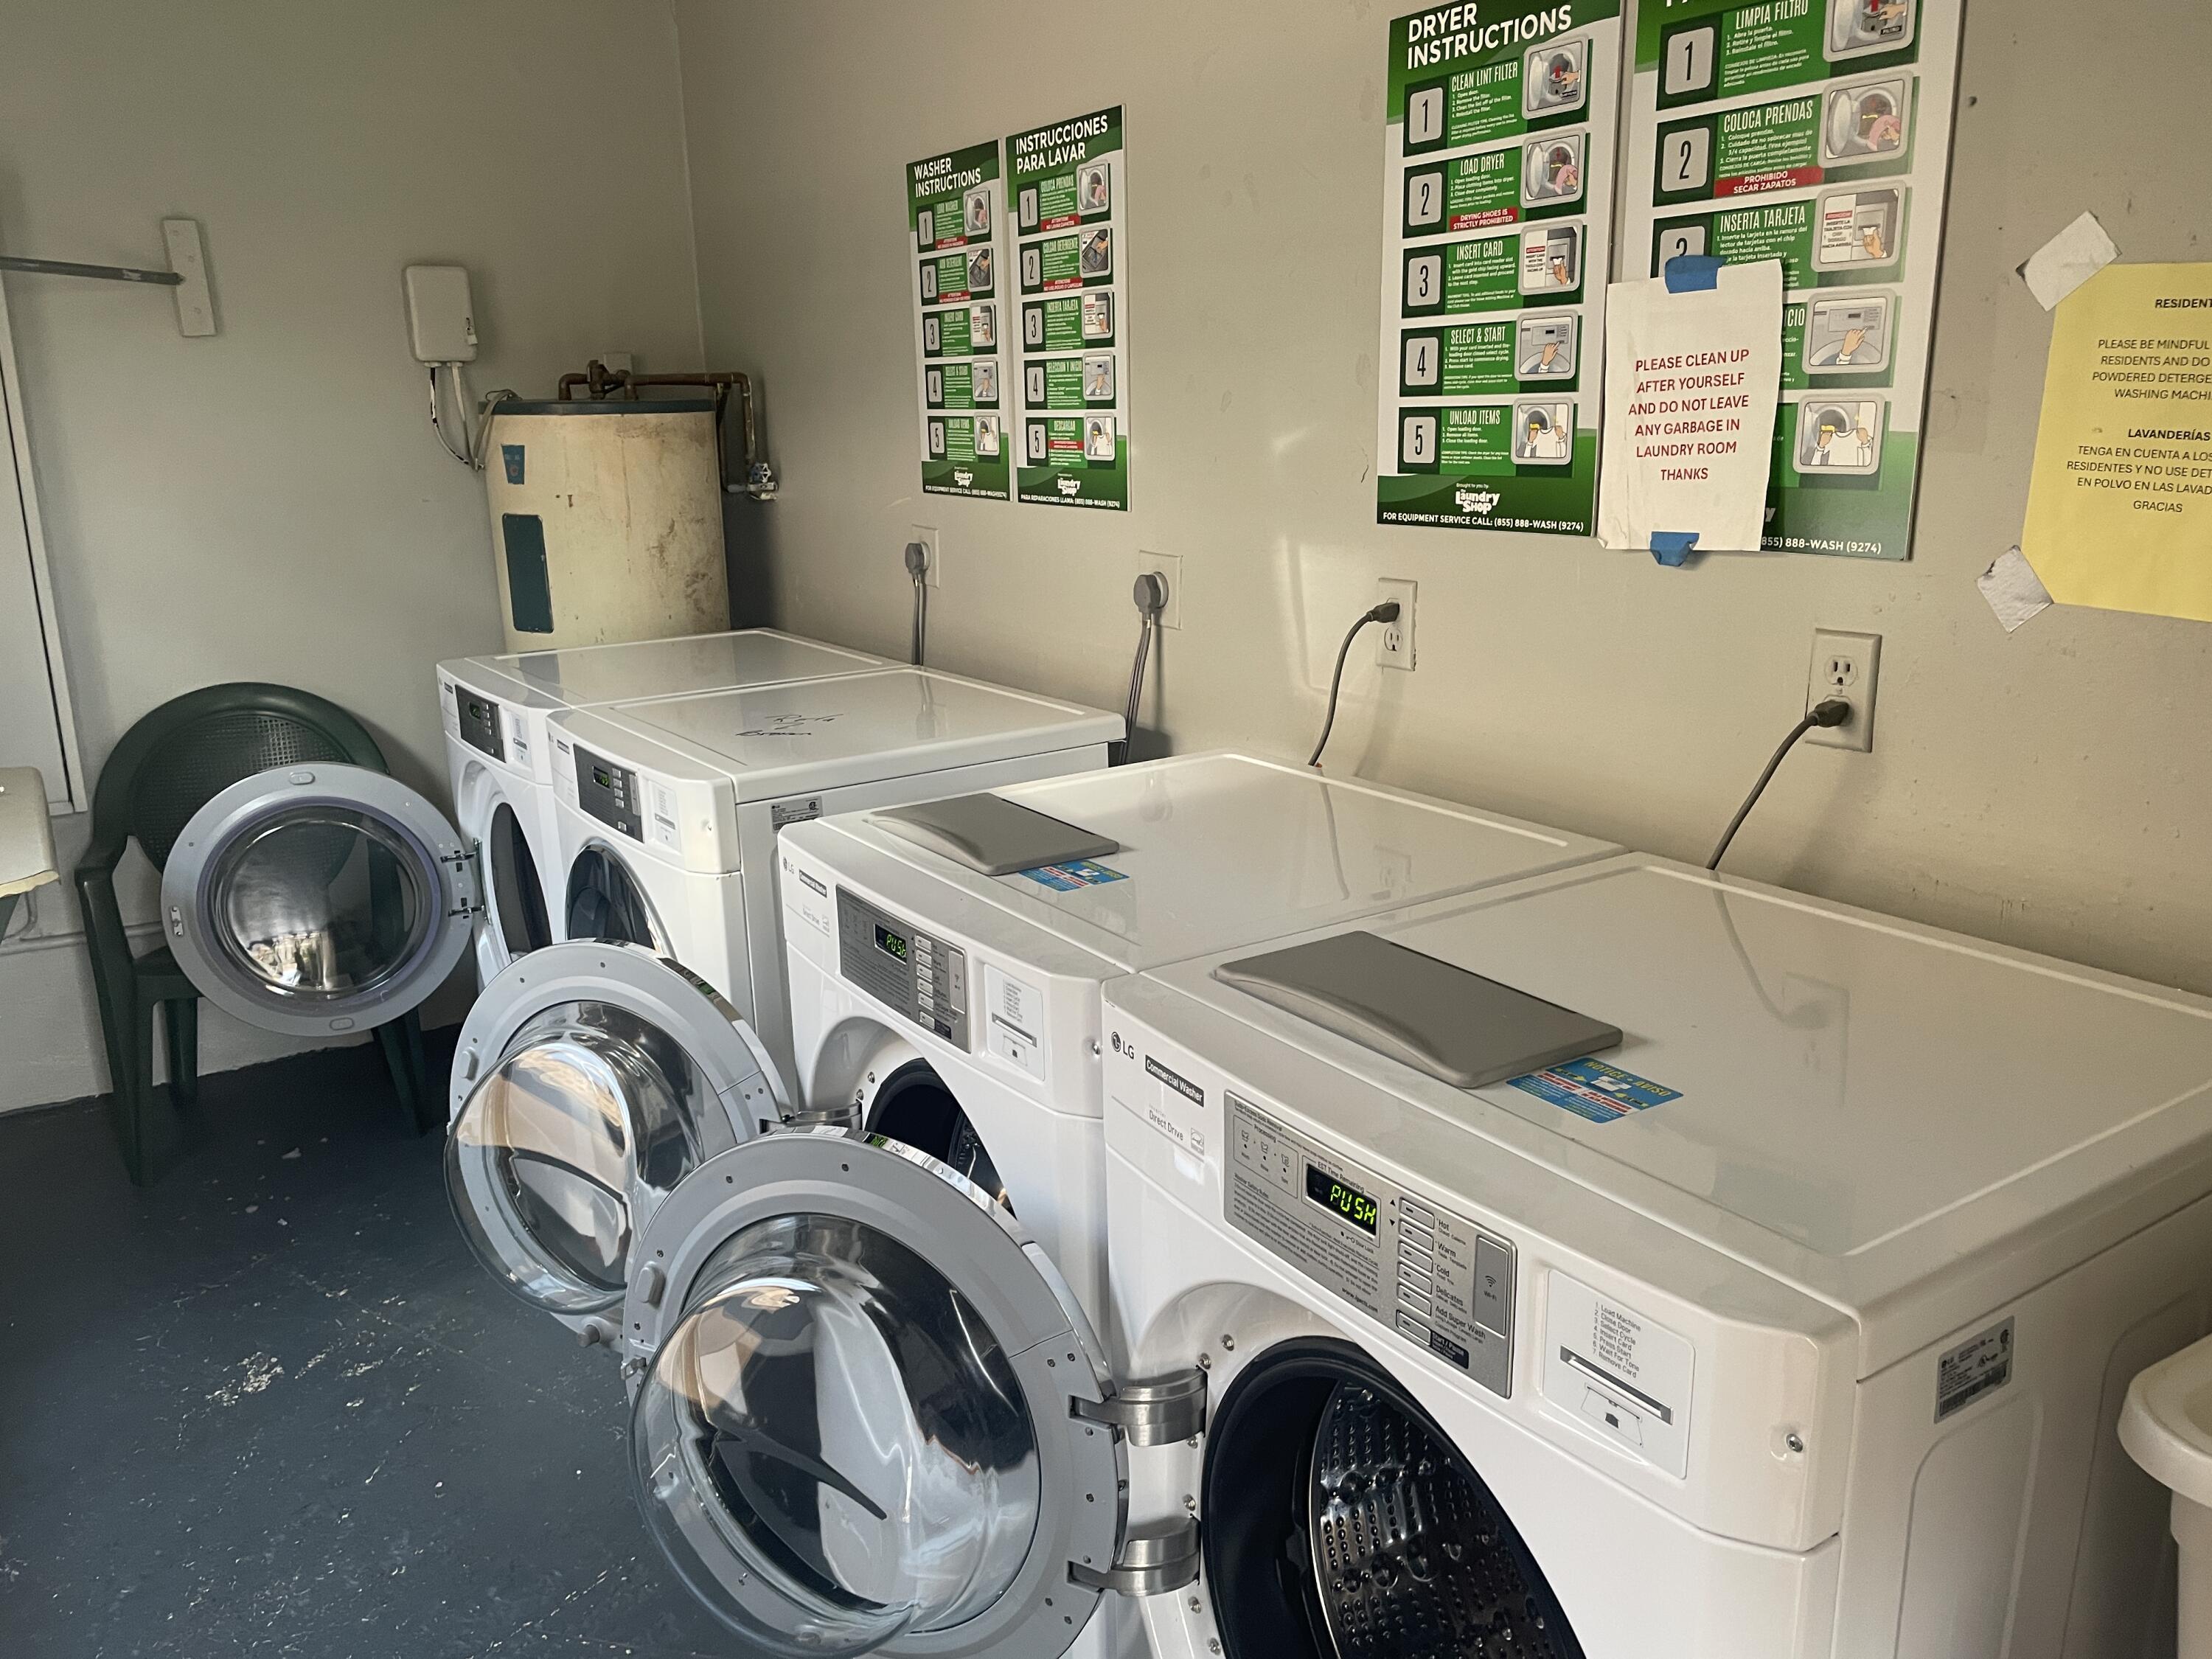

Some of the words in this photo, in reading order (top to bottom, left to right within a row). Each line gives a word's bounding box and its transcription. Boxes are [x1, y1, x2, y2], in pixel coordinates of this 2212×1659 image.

[1408, 2, 1478, 43] DRYER
[1736, 4, 1771, 29] LIMPIA
[1775, 0, 1809, 21] FILTRO
[1408, 4, 1572, 69] INSTRUCTIONS
[1685, 41, 1693, 81] 1
[1451, 72, 1475, 92] CLEAN
[1476, 68, 1492, 86] LINT
[1494, 61, 1518, 83] FILTER
[1422, 99, 1429, 133] 1
[1724, 110, 1761, 133] COLOCA
[1765, 100, 1813, 126] PRENDAS
[1016, 114, 1108, 155] INSTRUCCIONES
[914, 157, 952, 180] WASHER
[1016, 152, 1046, 175] PARA
[1048, 142, 1086, 167] LAVAR
[1460, 158, 1478, 176] LOAD
[1481, 153, 1505, 173] DRYER
[1679, 140, 1691, 179] 2
[915, 167, 981, 198] INSTRUCTIONS
[1733, 183, 1759, 194] SECAR
[1760, 178, 1797, 190] ZAPATOS
[1744, 170, 1788, 184] PROHIBIDO
[1421, 183, 1430, 216] 2
[1453, 220, 1478, 230] STRICTLY
[1479, 215, 1514, 226] PROHIBITED
[1460, 212, 1481, 222] DRYING
[1482, 209, 1501, 218] SHOES
[1720, 211, 1760, 233] INSERTA
[1764, 206, 1806, 228] TARJETA
[1456, 243, 1482, 261] INSERT
[1483, 240, 1503, 257] CARD
[1029, 255, 1034, 279] 2
[927, 271, 932, 292] 2
[1419, 265, 1429, 297] 3
[930, 324, 935, 345] 3
[1031, 314, 1037, 338] 3
[1450, 328, 1475, 344] SELECT
[1476, 327, 1482, 343] &
[1484, 326, 1506, 342] START
[2098, 339, 2138, 349] PLEASE
[2140, 339, 2154, 349] BE
[2157, 340, 2210, 350] MINDFUL
[1416, 346, 1426, 377] 4
[1635, 355, 1683, 372] PLEASE
[1686, 351, 1727, 366] CLEAN
[1731, 349, 1750, 363] UP
[2101, 356, 2161, 366] RESIDENTS
[2162, 357, 2189, 366] AND
[2191, 357, 2211, 367] DO
[1033, 373, 1038, 396] 4
[1636, 379, 1676, 394] AFTER
[1679, 372, 1745, 391] YOURSELF
[2092, 372, 2156, 382] POWDERED
[1628, 403, 1656, 416] AND
[1659, 400, 1679, 414] DO
[1681, 398, 1707, 411] NOT
[1710, 394, 1750, 410] LEAVE
[2114, 389, 2169, 400] WASHING
[1450, 409, 1477, 425] UNLOAD
[1479, 409, 1500, 425] ITEMS
[1635, 423, 1662, 437] ANY
[1663, 419, 1723, 435] GARBAGE
[1726, 418, 1740, 431] IN
[1034, 431, 1040, 453] 5
[1415, 425, 1423, 455] 5
[2128, 428, 2211, 442] LAVANDERÍAS
[1636, 443, 1694, 458] LAUNDRY
[1697, 441, 1737, 455] ROOM
[2078, 445, 2112, 456] TENGA
[2115, 448, 2131, 457] EN
[2133, 448, 2180, 460] CUENTA
[2182, 451, 2190, 460] A
[1660, 467, 1709, 481] THANKS
[2067, 461, 2133, 474] RESIDENTES
[2135, 465, 2143, 474] Y
[2144, 465, 2163, 476] NO
[2166, 467, 2188, 477] USE
[2077, 477, 2093, 487] EN
[2094, 479, 2132, 490] POLVO
[2134, 481, 2150, 491] EN
[2153, 481, 2174, 493] LAS
[2133, 500, 2183, 513] GRACIAS
[1382, 512, 1397, 521] FOR
[1398, 512, 1439, 522] EQUIPMENT
[1440, 515, 1471, 524] SERVICE
[1472, 517, 1493, 526] CALL:
[1494, 518, 1513, 528] (855)
[1514, 519, 1557, 529] 888-WASH
[1558, 521, 1584, 532] (9274)
[1761, 536, 1783, 549] 855)
[1785, 538, 1843, 551] 888-WASH
[1846, 540, 1882, 554] (9274)
[1123, 1040, 1135, 1060] LG
[1147, 1059, 1179, 1088] Commercial
[1179, 1079, 1203, 1102] Washer
[1150, 1109, 1166, 1130] Direct
[1168, 1121, 1183, 1141] Drive
[1329, 1184, 1377, 1225] PUSH
[1439, 1219, 1450, 1231] Hot
[1438, 1242, 1456, 1258] Warm
[1436, 1265, 1450, 1277] Cold
[1436, 1285, 1464, 1307] Delicates
[1435, 1305, 1447, 1318] Add
[1448, 1312, 1467, 1328] Super
[1467, 1322, 1486, 1339] Wash
[1601, 1304, 1615, 1318] Load
[1616, 1313, 1641, 1332] Machine
